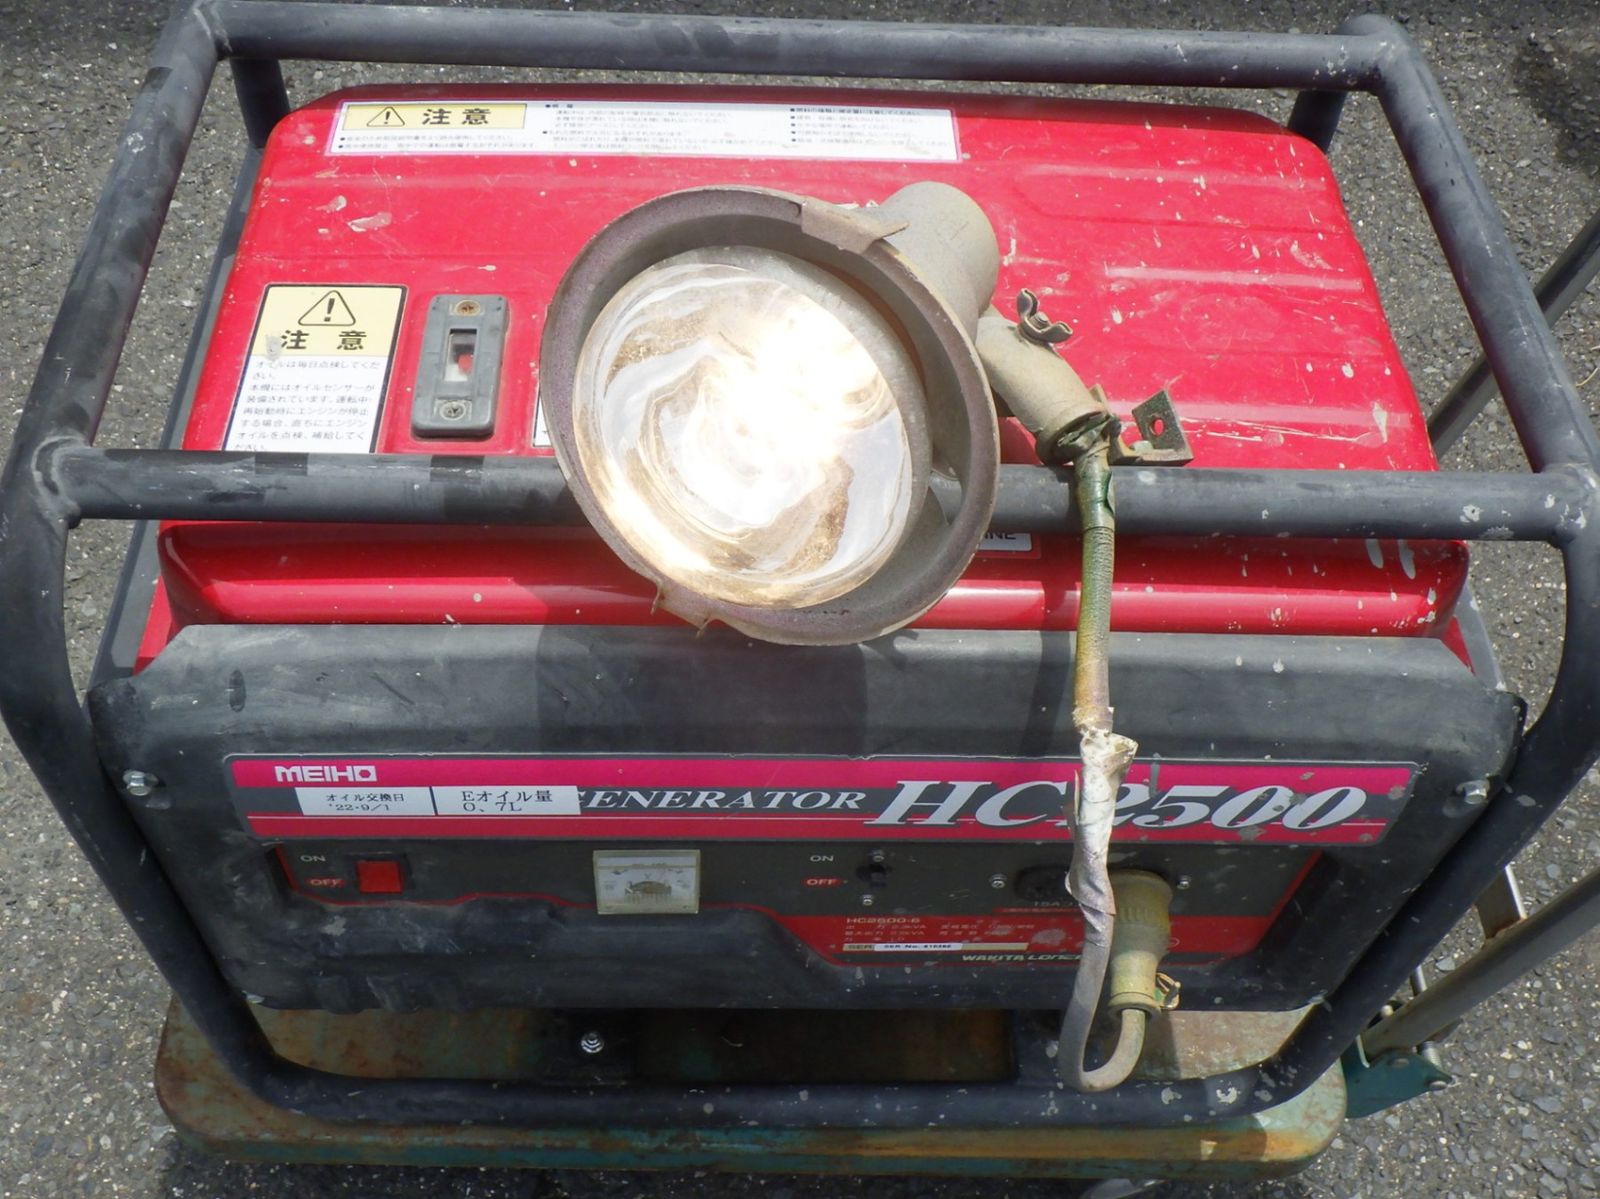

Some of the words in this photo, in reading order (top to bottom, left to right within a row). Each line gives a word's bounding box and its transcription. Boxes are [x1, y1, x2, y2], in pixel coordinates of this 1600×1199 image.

[421, 107, 491, 126] 注意
[280, 329, 367, 351] 注意
[274, 765, 378, 783] MEIHO
[326, 792, 404, 802] オイル交換日
[461, 789, 553, 802] Eオイル量
[576, 790, 867, 810] ENERATOR
[299, 855, 326, 863] ON
[809, 855, 835, 863] ON
[309, 878, 342, 887] OFF
[806, 878, 837, 886] OFF
